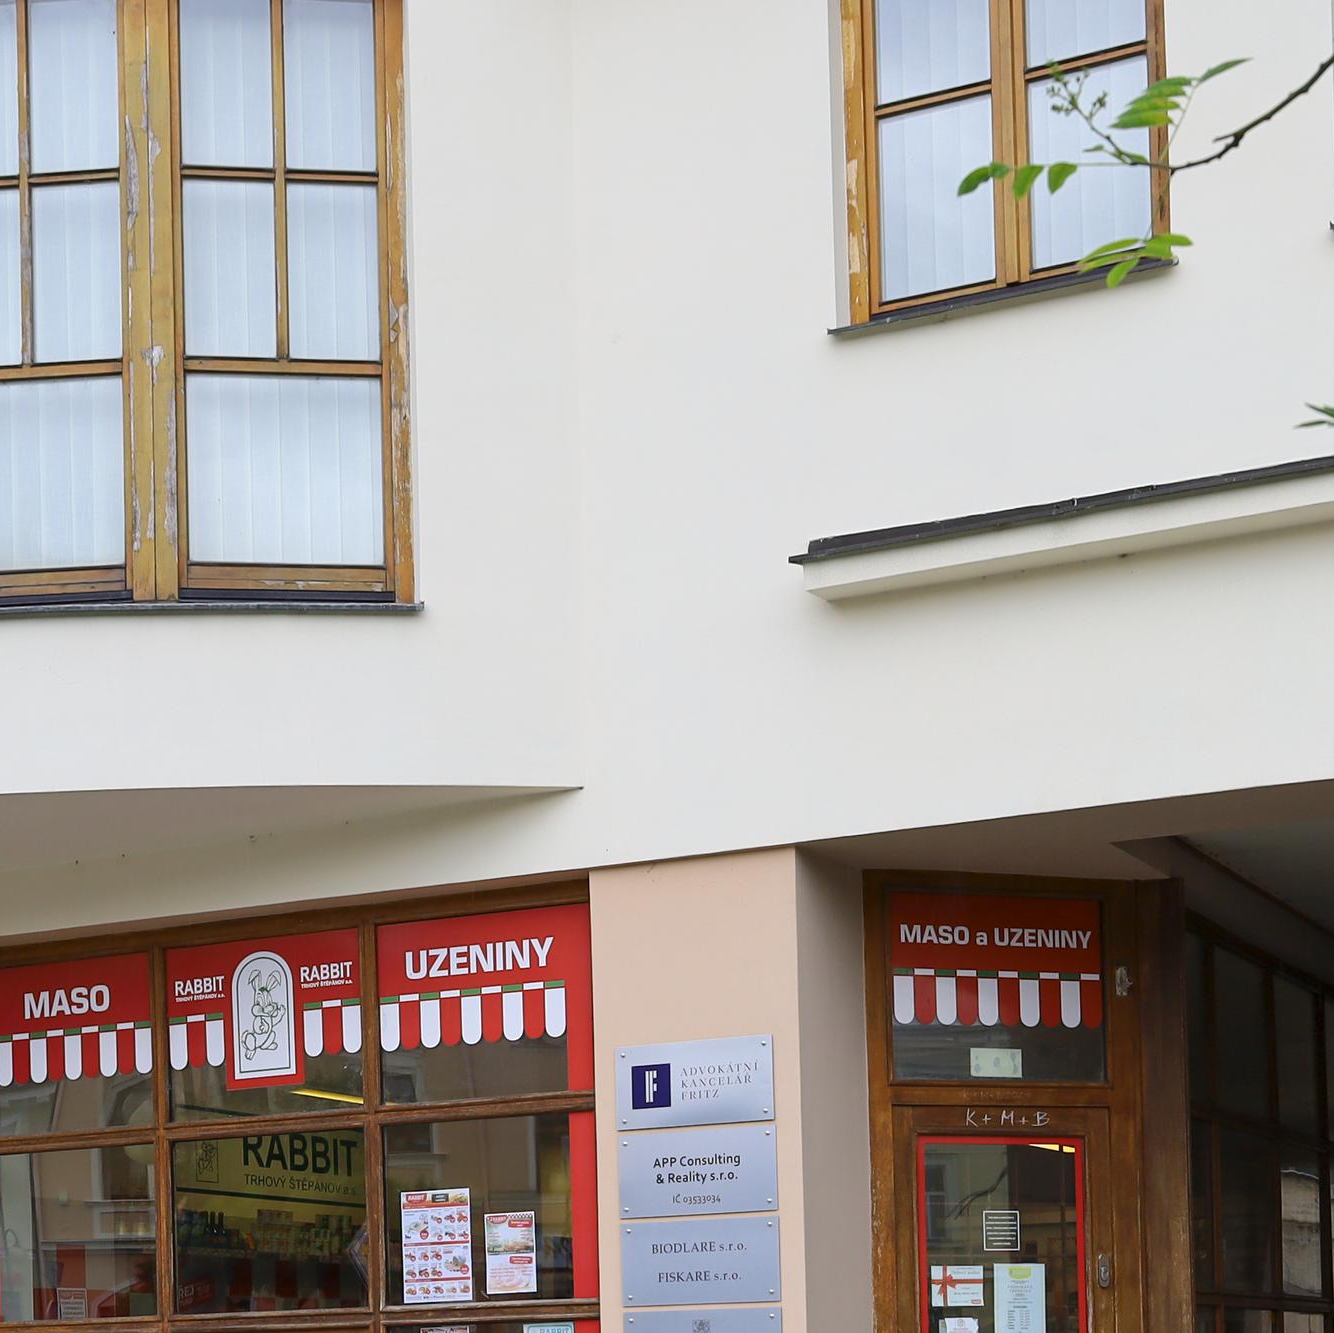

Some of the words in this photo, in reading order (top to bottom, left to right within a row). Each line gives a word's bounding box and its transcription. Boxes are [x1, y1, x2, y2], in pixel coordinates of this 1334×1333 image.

[899, 923, 970, 946] MASO
[975, 932, 988, 946] a
[993, 927, 1092, 950] UZENINY
[404, 936, 555, 981] UZENINY
[300, 960, 353, 983] RABBIT
[174, 975, 225, 996] RABBIT
[23, 984, 111, 1020] MASO
[681, 1088, 720, 1100] FRITZ
[242, 1131, 358, 1177] RABBIT
[653, 1157, 677, 1168] APP
[679, 1153, 741, 1167] Consulting
[244, 1173, 286, 1188] TRHOVÝ
[656, 1173, 664, 1184] &
[668, 1170, 707, 1184] Reality
[710, 1171, 738, 1181] s.r.o.
[651, 1241, 716, 1254] BIODLARE
[658, 1270, 711, 1283] FISKARE
